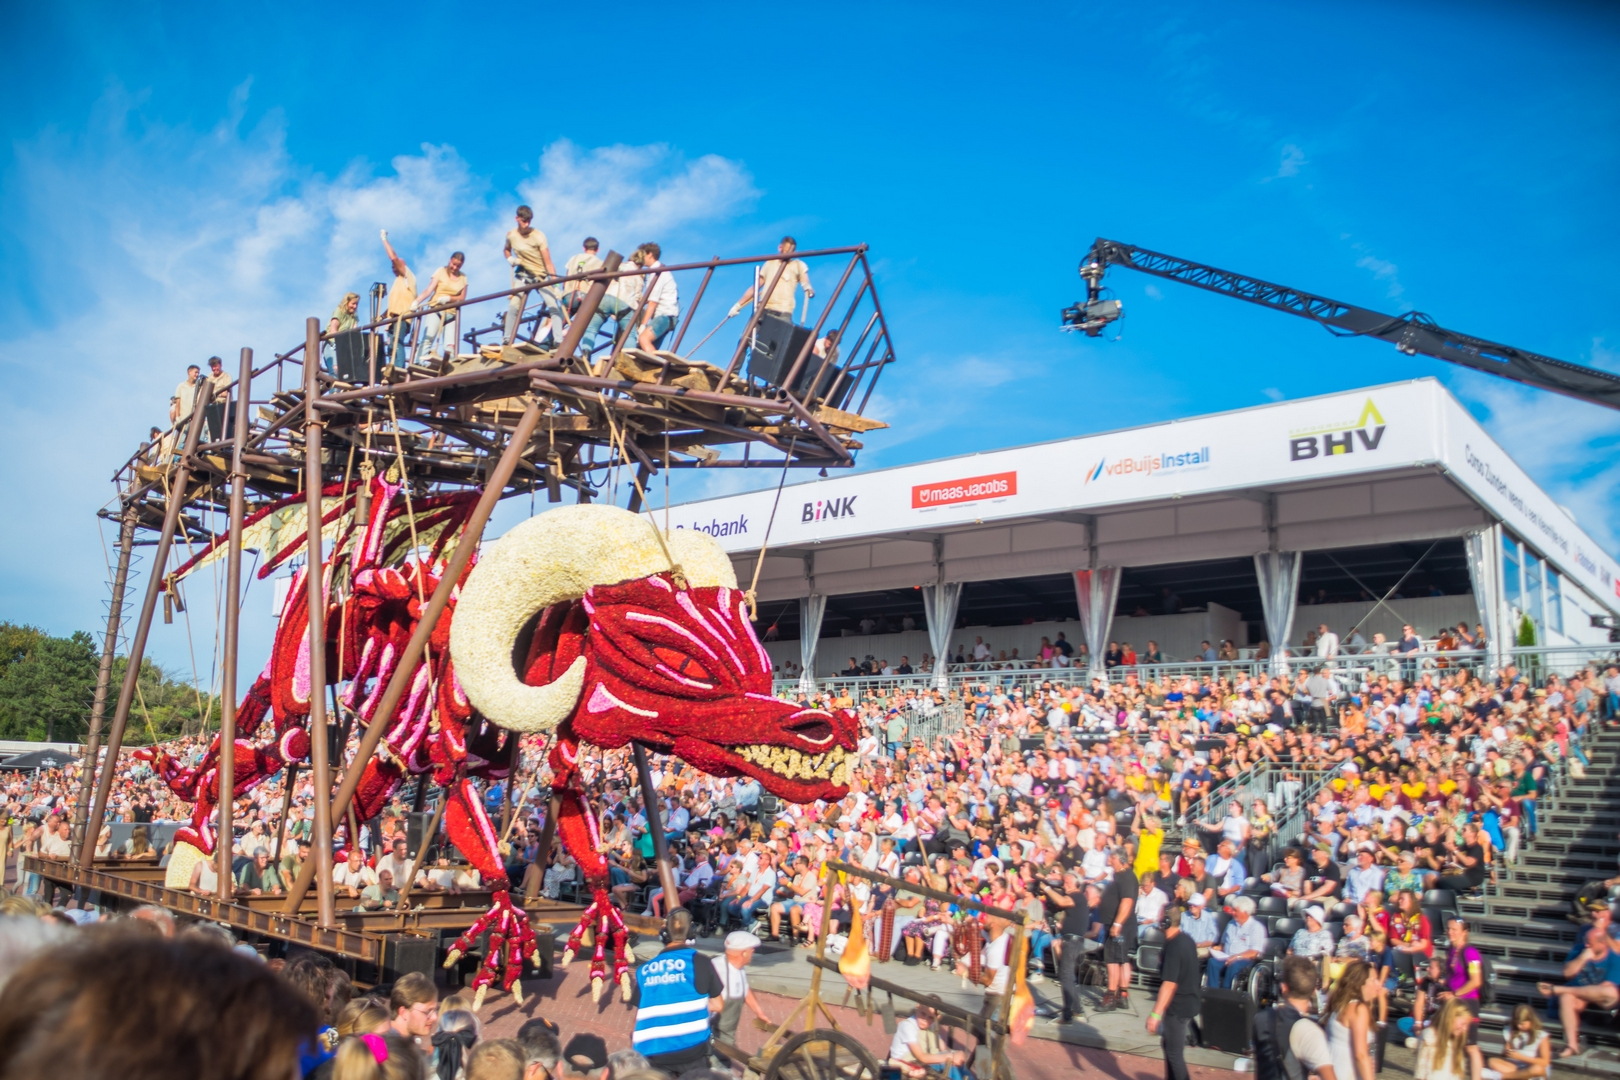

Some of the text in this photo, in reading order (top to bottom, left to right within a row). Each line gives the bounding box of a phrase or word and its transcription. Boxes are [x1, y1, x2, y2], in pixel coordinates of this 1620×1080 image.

[1290, 425, 1386, 461] BHV
[1105, 446, 1209, 476] vdBuijsInstall
[1465, 443, 1484, 477] Corso
[676, 513, 748, 538] bobank
[641, 958, 686, 976] corso
